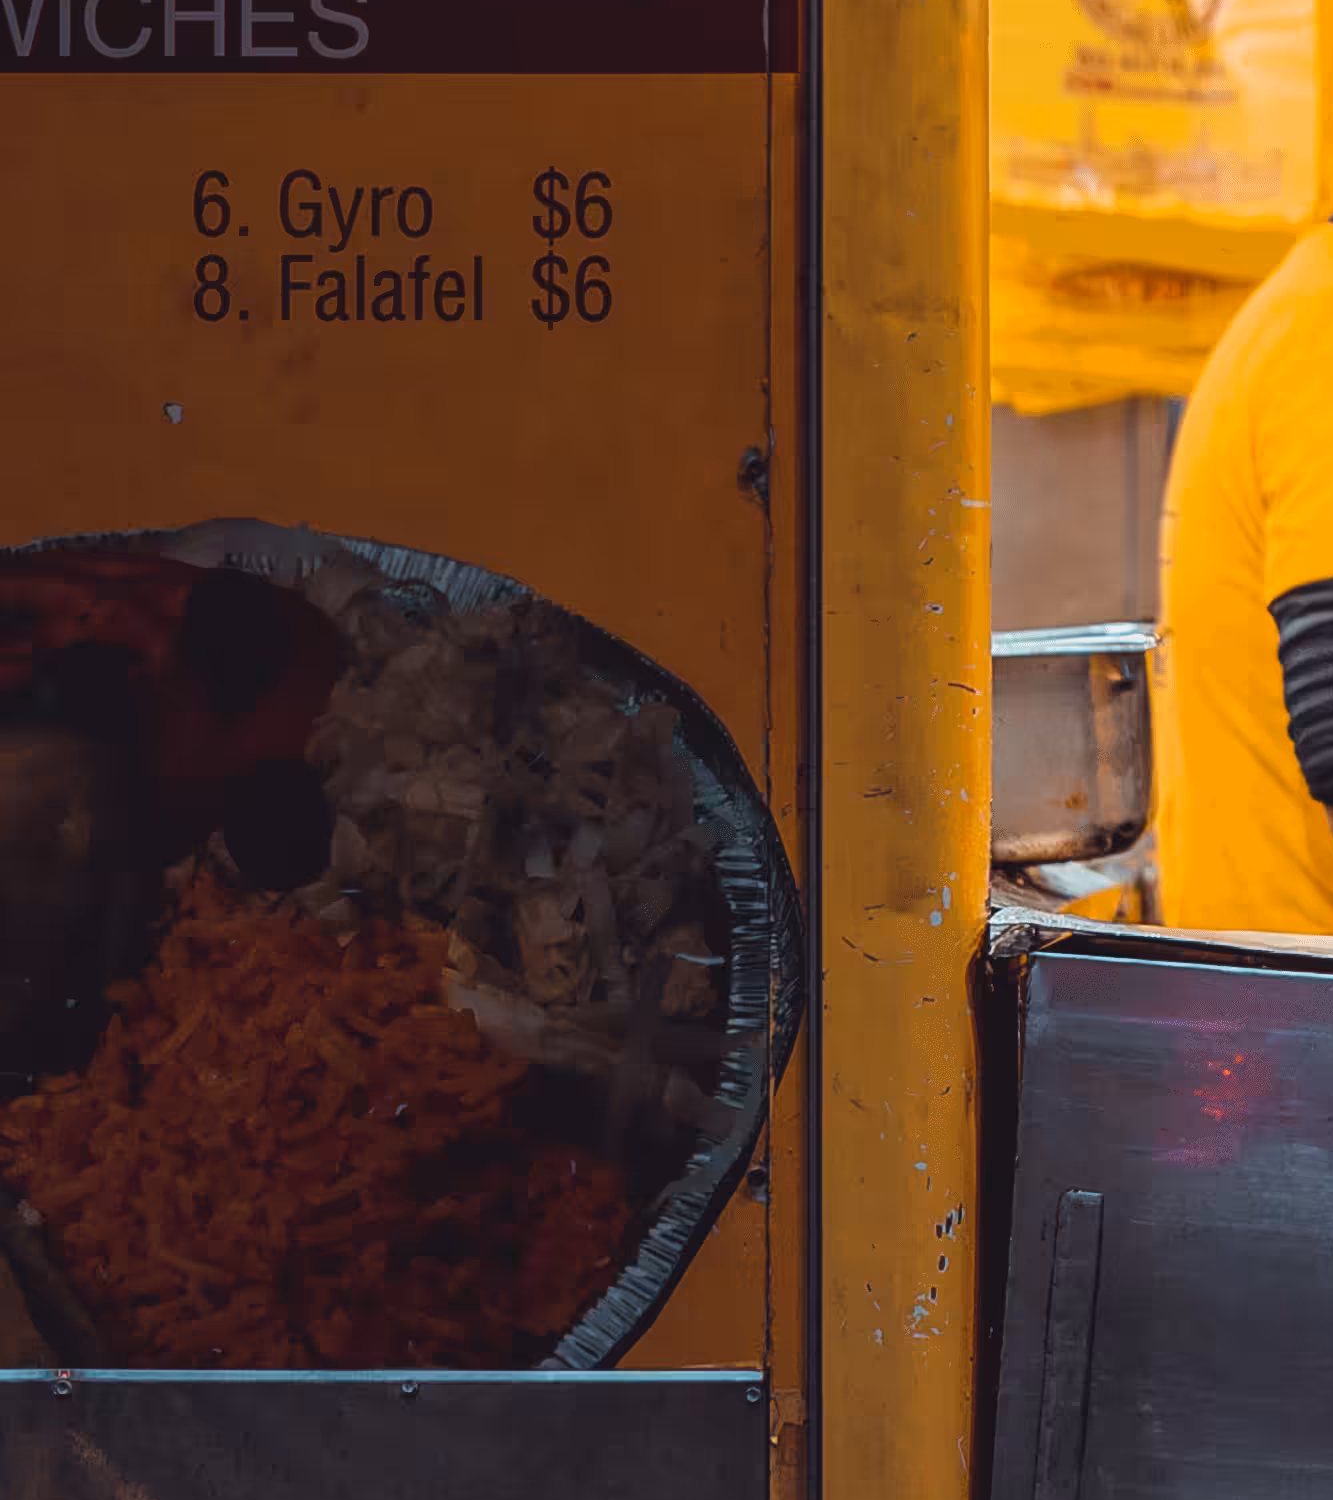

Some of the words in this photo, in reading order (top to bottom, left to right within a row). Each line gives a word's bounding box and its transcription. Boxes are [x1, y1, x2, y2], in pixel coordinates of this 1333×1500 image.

[193, 169, 249, 238] 6.
[279, 168, 433, 253] Gyro
[532, 165, 613, 247] $6
[193, 253, 249, 323] 8.
[280, 254, 483, 323] Falafel
[531, 249, 613, 332] $6
